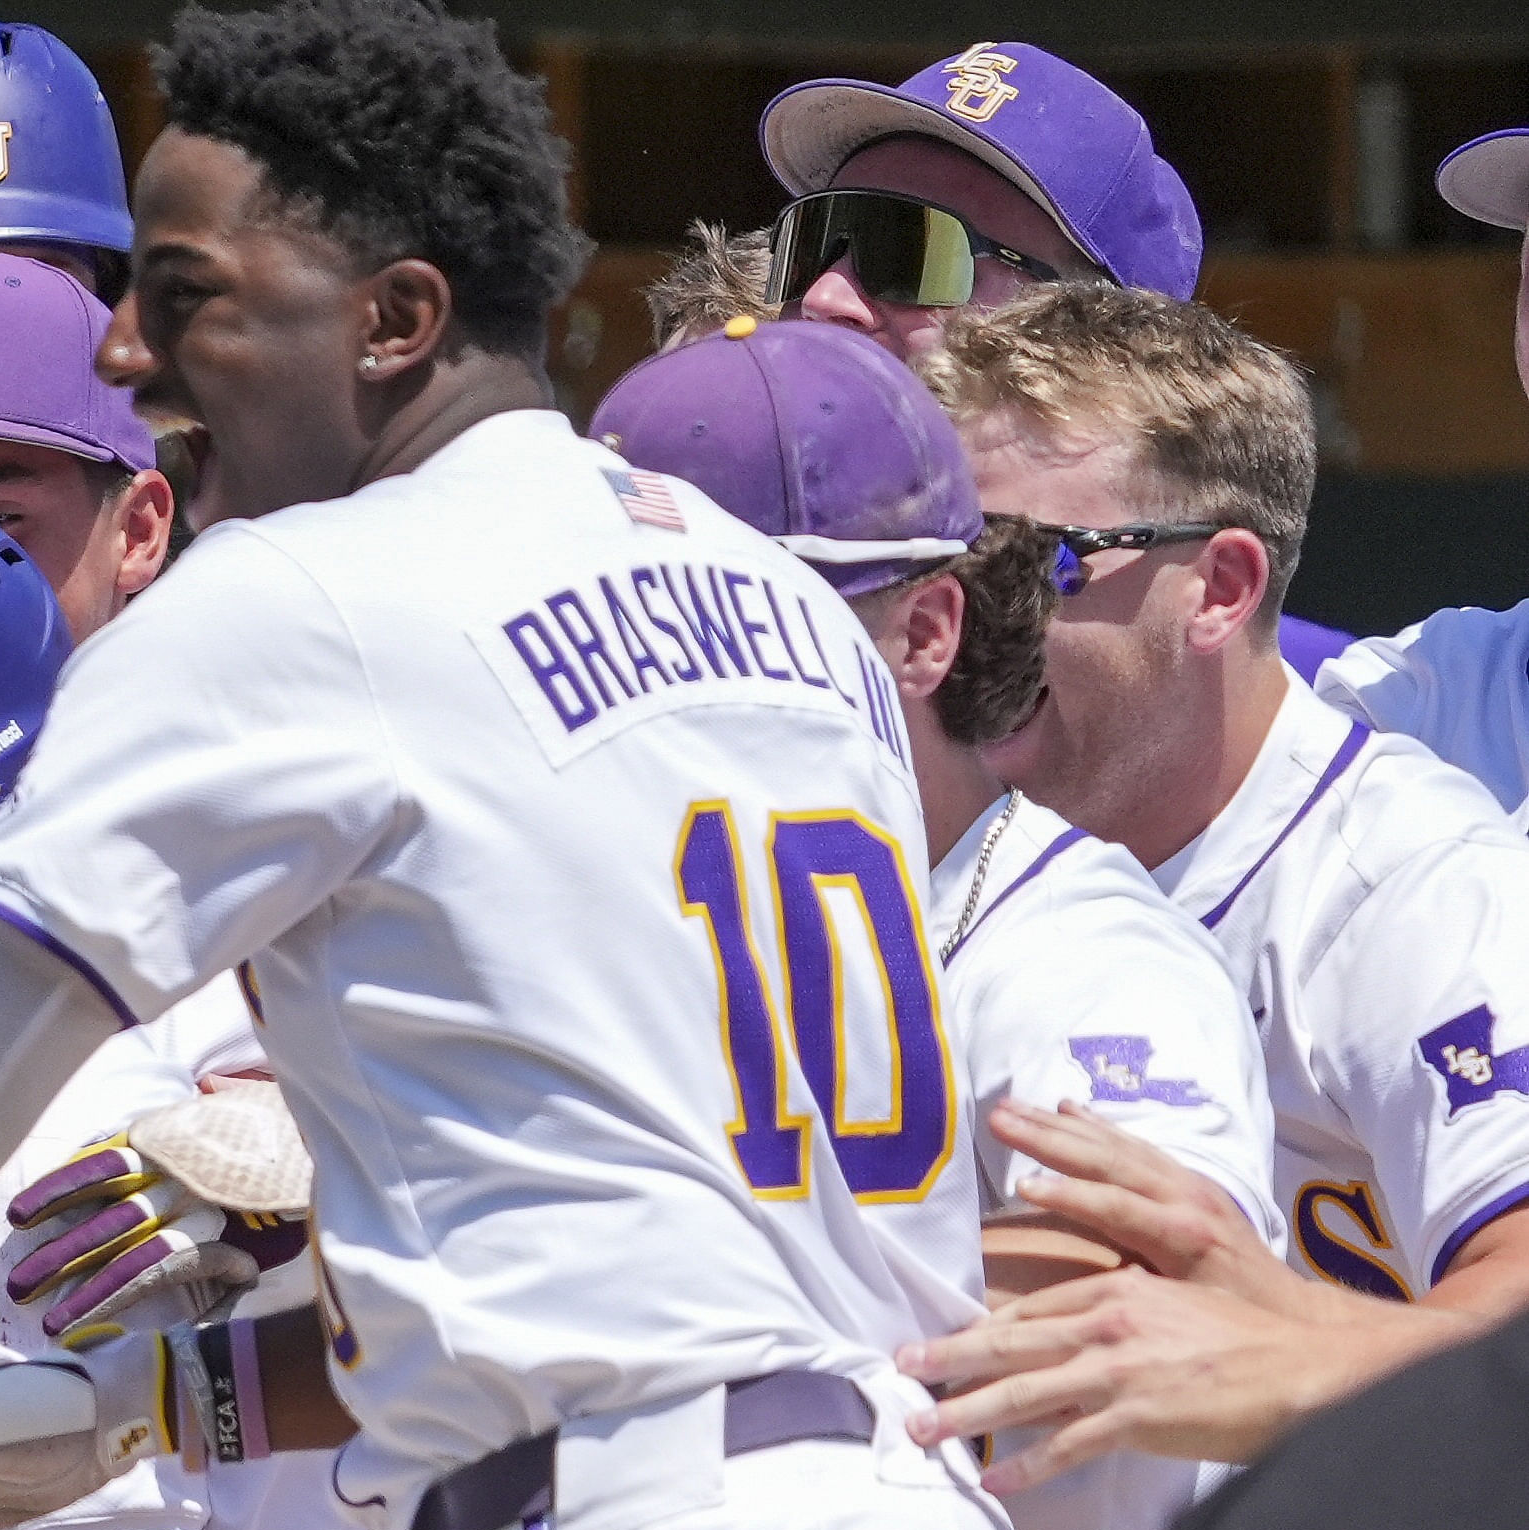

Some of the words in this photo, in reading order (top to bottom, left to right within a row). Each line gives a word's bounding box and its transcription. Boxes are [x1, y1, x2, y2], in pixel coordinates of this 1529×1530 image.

[943, 42, 1019, 123] LSU
[502, 562, 859, 733] BRASWELL
[672, 797, 958, 1206] 10
[1441, 1043, 1495, 1087] LSU
